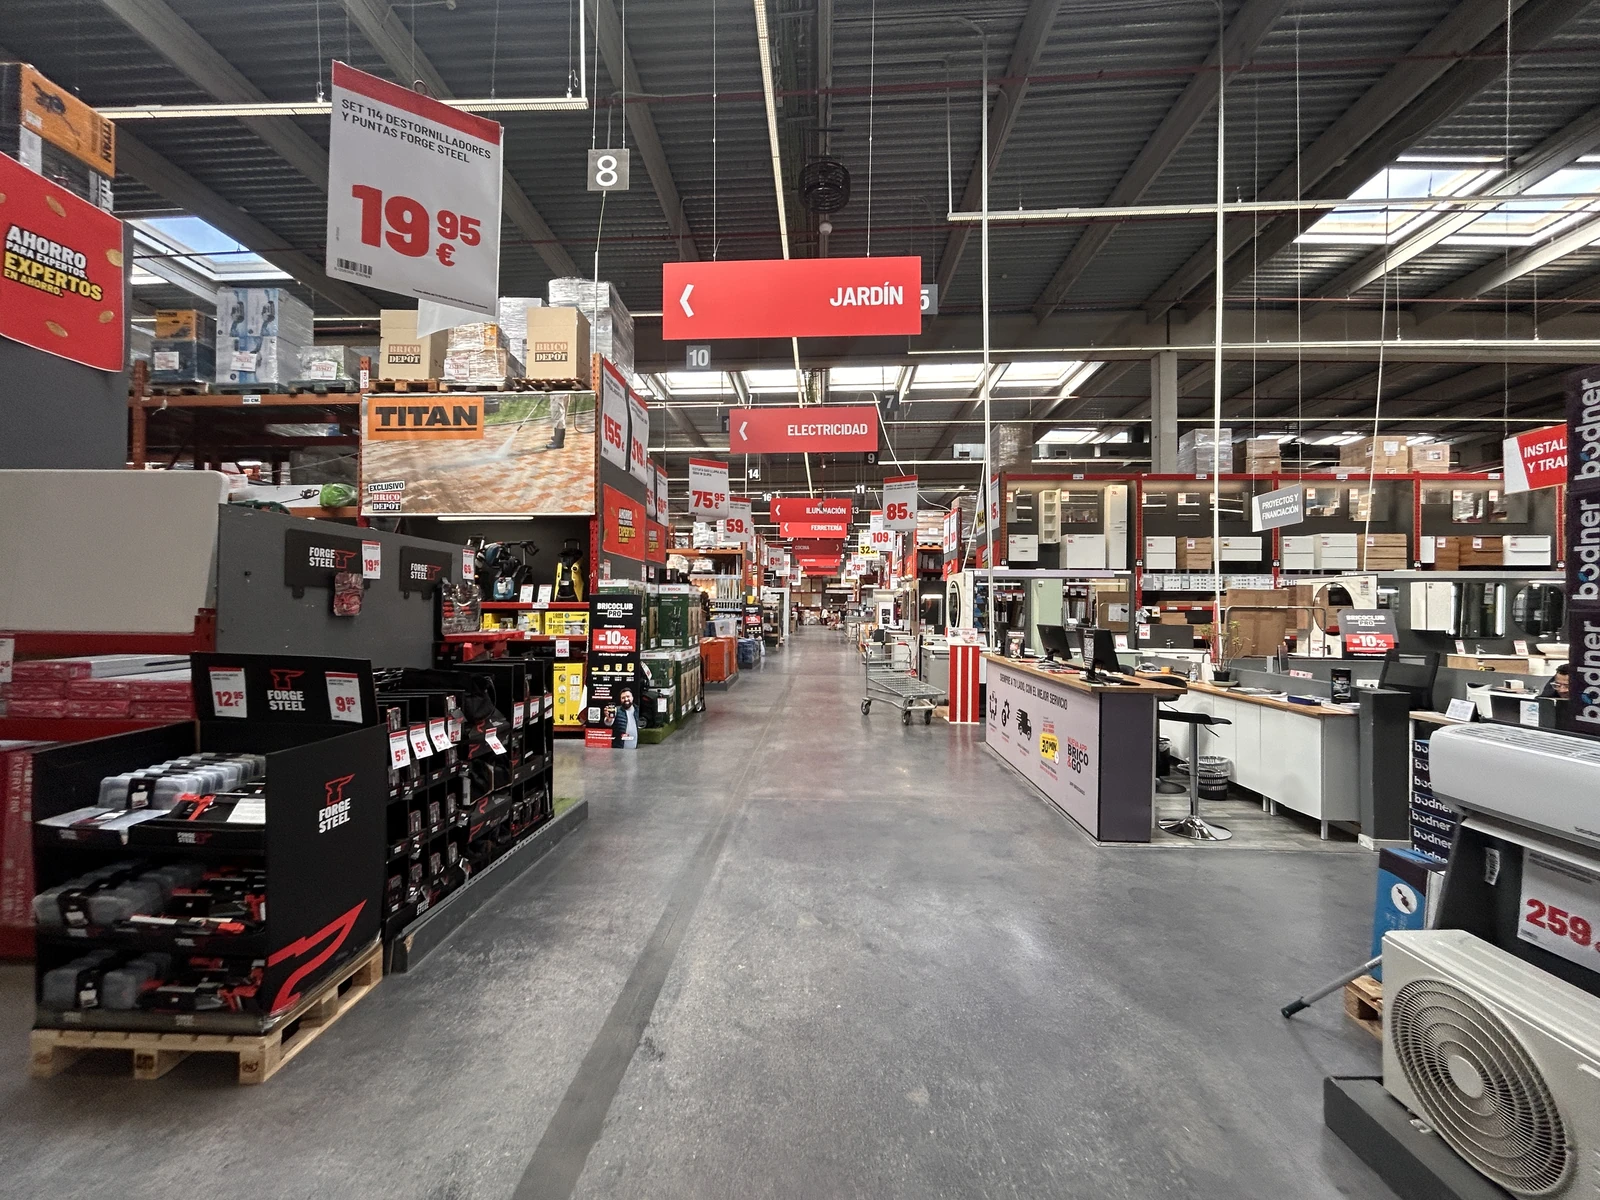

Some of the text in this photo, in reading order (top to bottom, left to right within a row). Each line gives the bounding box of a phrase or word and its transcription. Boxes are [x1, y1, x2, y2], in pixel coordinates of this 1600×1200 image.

[341, 98, 491, 160] SET 114 DESTORNILLADORES
[101, 122, 112, 164] TITAN
[341, 111, 470, 164] Y PUNTAS FORGE STEEL
[596, 155, 618, 188] 8
[351, 184, 481, 258] 19 95
[5, 223, 87, 270] AHORRO
[5, 239, 88, 280] PARA EXPERTOS.
[4, 251, 103, 302] EXPERTOS
[4, 268, 64, 298] EN AHORRO.
[829, 282, 904, 307] JARDÍN
[920, 289, 930, 310] 5
[389, 344, 421, 354] BRICO
[534, 342, 568, 352] BRICO
[388, 353, 420, 364] DEPÔT
[534, 352, 568, 363] DEPÔT
[689, 349, 708, 367] 10
[884, 395, 894, 409] 7
[375, 406, 478, 426] TITAN
[604, 416, 622, 449] 155
[787, 424, 868, 437] ELECTRICIDAD
[1574, 378, 1600, 480] bodner
[868, 453, 875, 464] 9
[748, 468, 759, 479] 14
[1527, 462, 1536, 474] Y
[369, 483, 404, 492] EXCLUSIVO
[855, 484, 865, 494] 11
[372, 492, 402, 502] BRICO
[692, 490, 725, 508] 75 95
[762, 493, 772, 502] 16
[1262, 494, 1299, 510] PROYECTOS Y
[372, 500, 402, 510] DEPÔT
[852, 506, 859, 514] 13
[886, 502, 908, 520] 85
[1262, 504, 1299, 521] FINANCIACIÓN
[726, 518, 744, 533] 59
[872, 532, 888, 543] 109
[309, 546, 335, 559] FORGE
[1573, 499, 1600, 600] bodner
[309, 556, 335, 568] STEEL
[364, 559, 373, 572] 19
[410, 562, 428, 572] FORGE
[410, 571, 427, 580] STEEL
[597, 602, 633, 610] BRICOCLUB
[1576, 621, 1600, 723] bodner
[215, 691, 233, 707] 12
[267, 690, 304, 701] FORGE
[1000, 673, 1010, 686] SIEMPRE
[1017, 681, 1025, 692] LADO,
[1033, 686, 1037, 696] EL
[1037, 688, 1049, 703] MEJOR
[1050, 693, 1068, 710] SERVICIO
[269, 700, 306, 711] STEEL
[335, 696, 346, 712] 9
[450, 731, 456, 740] 5
[415, 742, 422, 752] 5
[1042, 740, 1048, 754] 30
[395, 751, 401, 762] 5
[1067, 744, 1089, 766] BRICO
[1071, 760, 1081, 774] GO
[319, 798, 351, 822] FORGE
[319, 810, 350, 834] STEEL
[1412, 810, 1451, 832] bodner
[1526, 898, 1591, 947] 259
